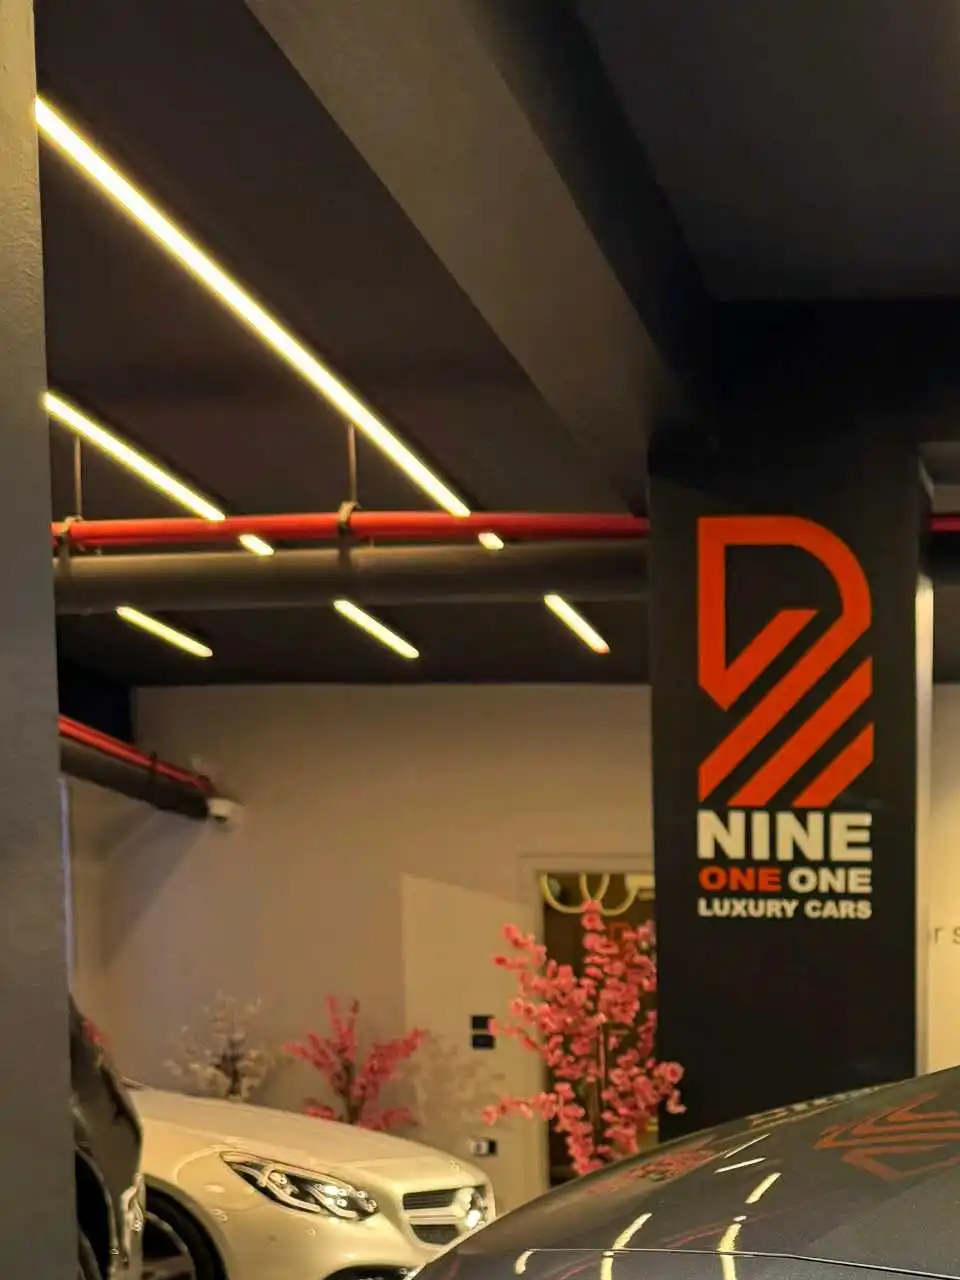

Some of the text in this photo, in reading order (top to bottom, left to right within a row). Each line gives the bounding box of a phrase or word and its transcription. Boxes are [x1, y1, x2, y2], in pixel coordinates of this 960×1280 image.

[697, 810, 873, 861] NINE
[699, 866, 873, 893] ONE ONE
[697, 897, 873, 919] LUXURY CARS
